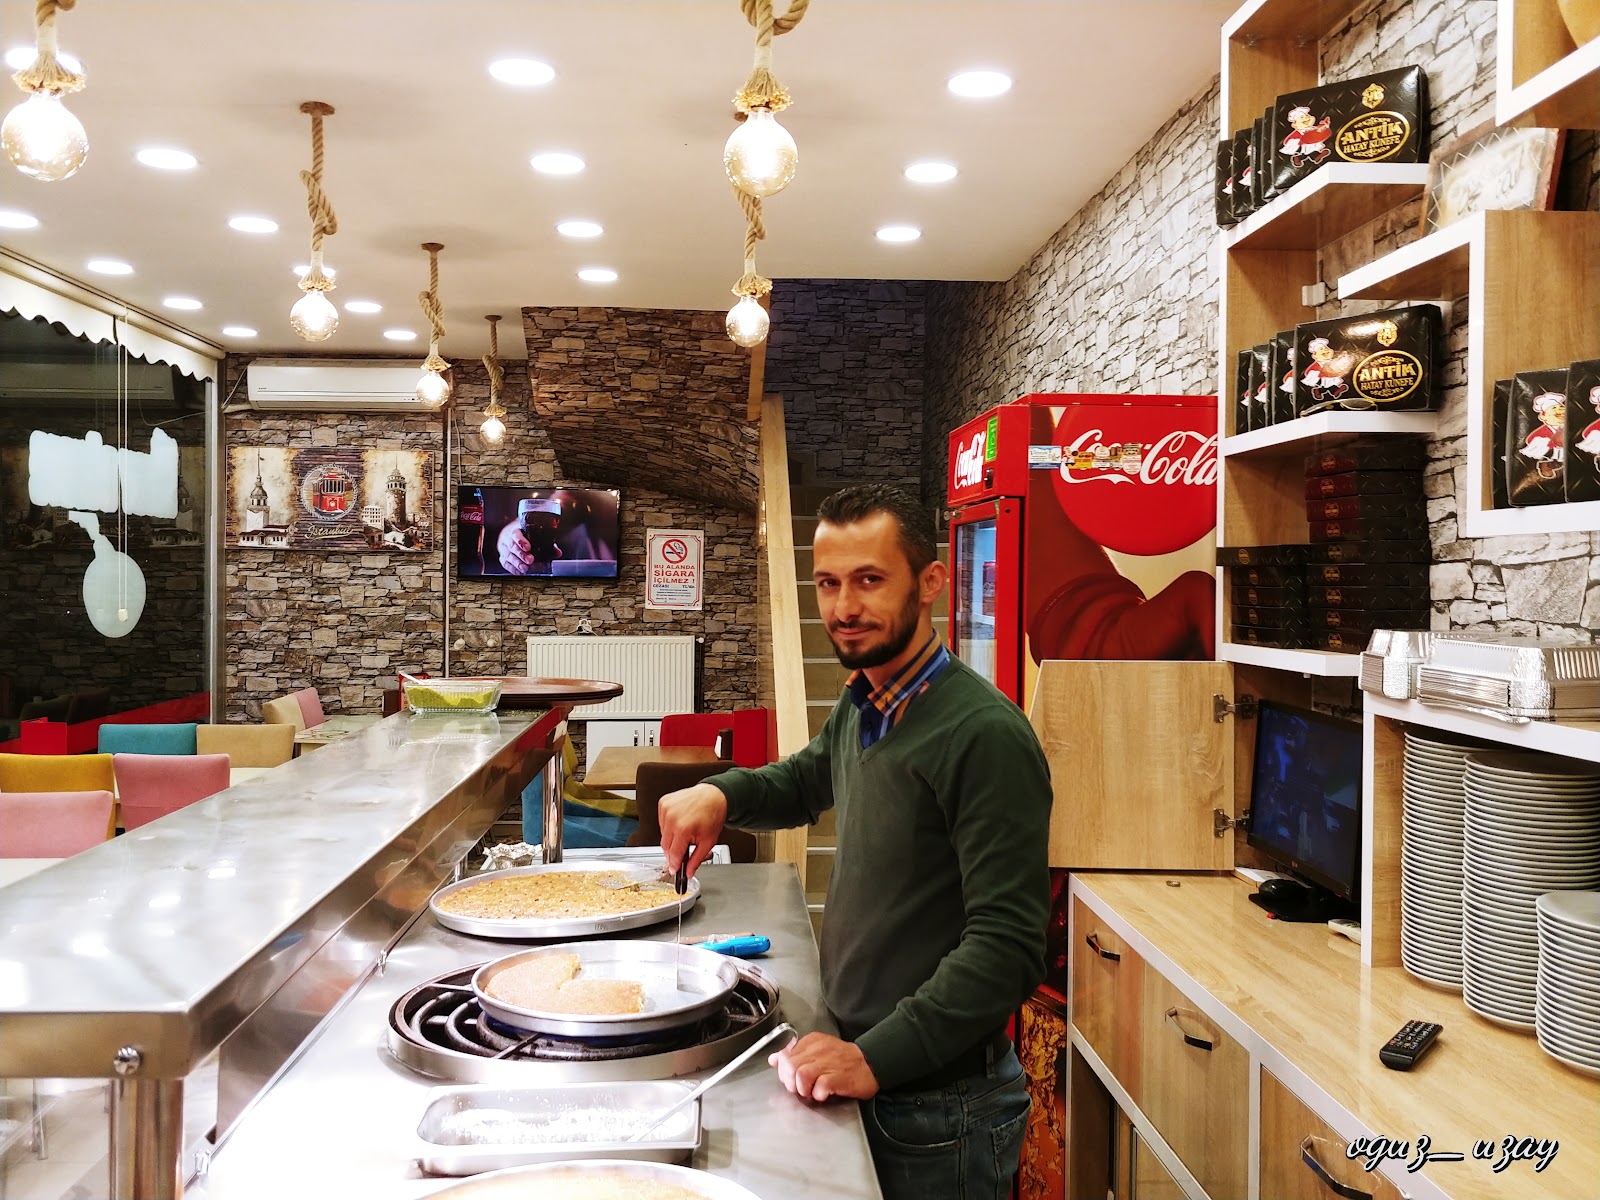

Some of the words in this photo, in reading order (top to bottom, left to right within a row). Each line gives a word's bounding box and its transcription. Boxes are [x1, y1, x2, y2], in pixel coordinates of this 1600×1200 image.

[1340, 121, 1403, 145] ANTİK
[1343, 141, 1369, 154] HATAY
[1358, 362, 1417, 381] ANTİK
[1361, 381, 1384, 391] HATAY
[654, 569, 695, 577] SİGARA
